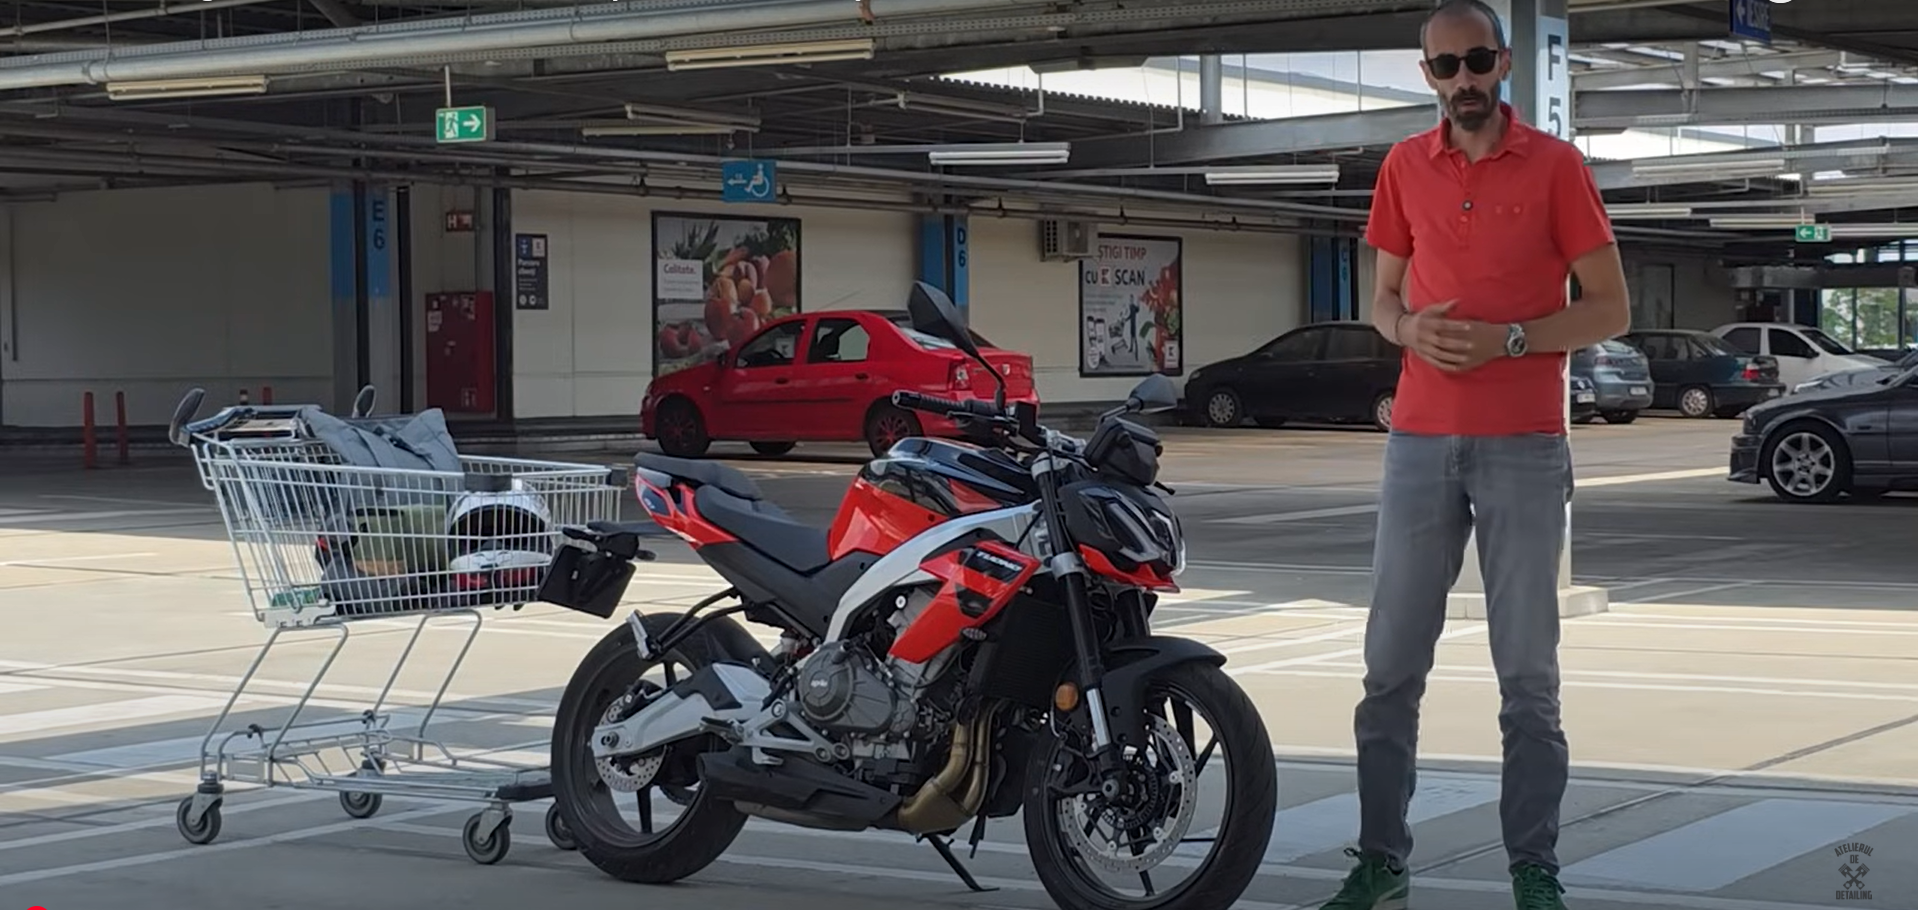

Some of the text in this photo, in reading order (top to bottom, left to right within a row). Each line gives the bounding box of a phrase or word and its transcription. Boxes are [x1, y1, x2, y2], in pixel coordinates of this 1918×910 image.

[1548, 34, 1561, 80] F
[1548, 97, 1561, 138] 5
[372, 201, 385, 221] E
[447, 214, 457, 229] H
[373, 229, 385, 249] 6
[957, 227, 966, 244] D
[958, 250, 967, 267] 6
[1124, 245, 1147, 260] TIMP
[663, 263, 697, 274] Calitate.
[1085, 270, 1098, 284] CU
[1115, 268, 1145, 286] SCAN
